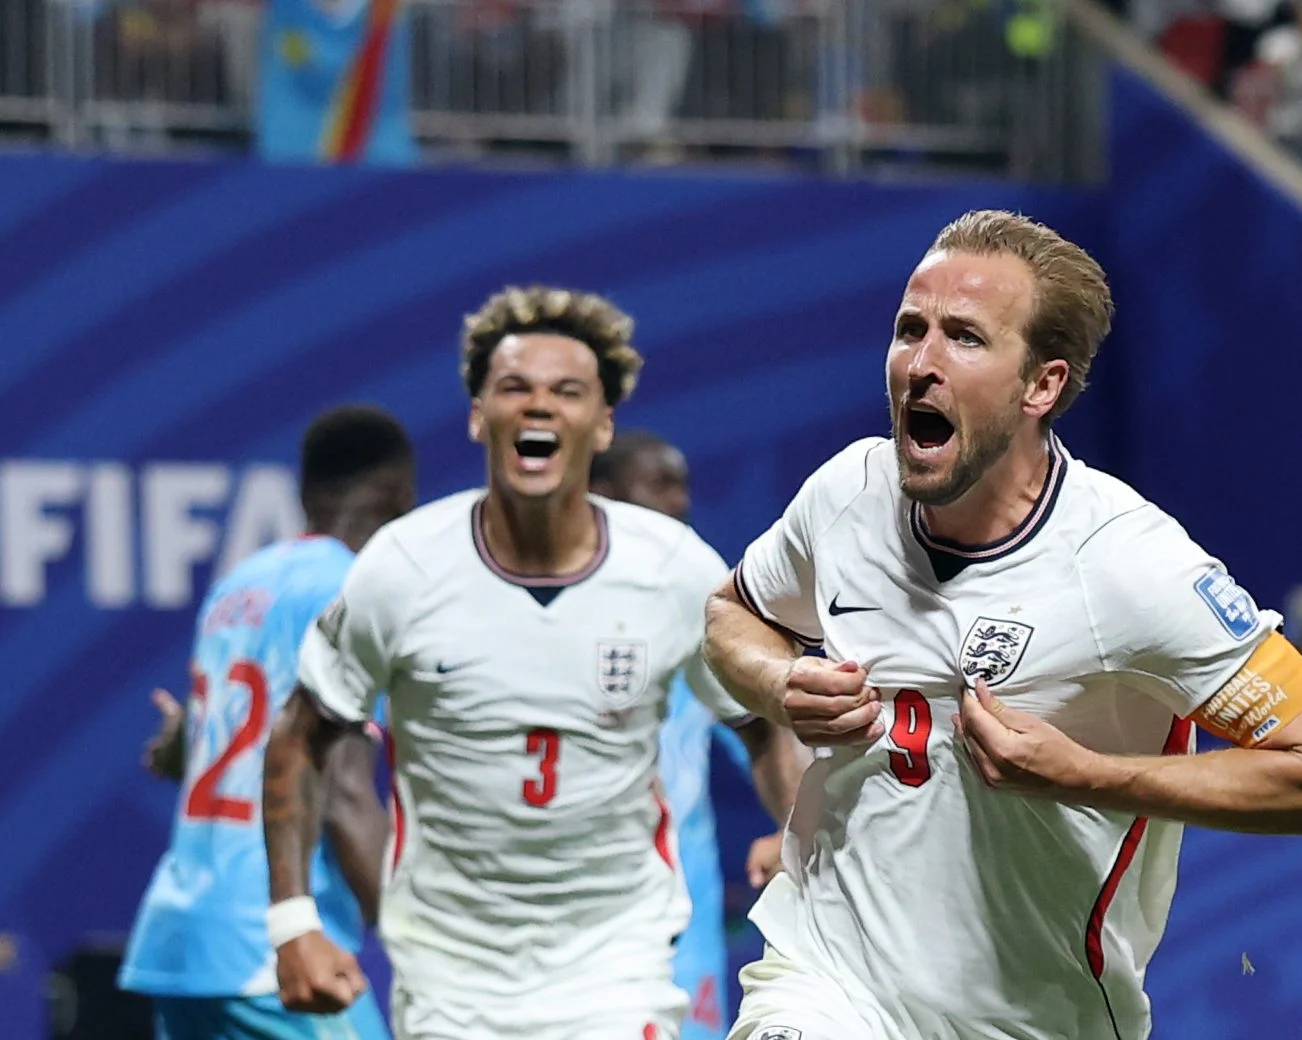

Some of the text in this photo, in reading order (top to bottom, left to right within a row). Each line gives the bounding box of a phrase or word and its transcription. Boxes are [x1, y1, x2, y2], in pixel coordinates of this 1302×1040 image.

[2, 460, 308, 607] FIFA
[1202, 668, 1259, 720] FOOTBALL
[1211, 675, 1272, 730] UNITES
[1245, 685, 1288, 727] World
[889, 688, 932, 788] 9
[1254, 718, 1278, 738] FIFA
[523, 727, 560, 808] 3
